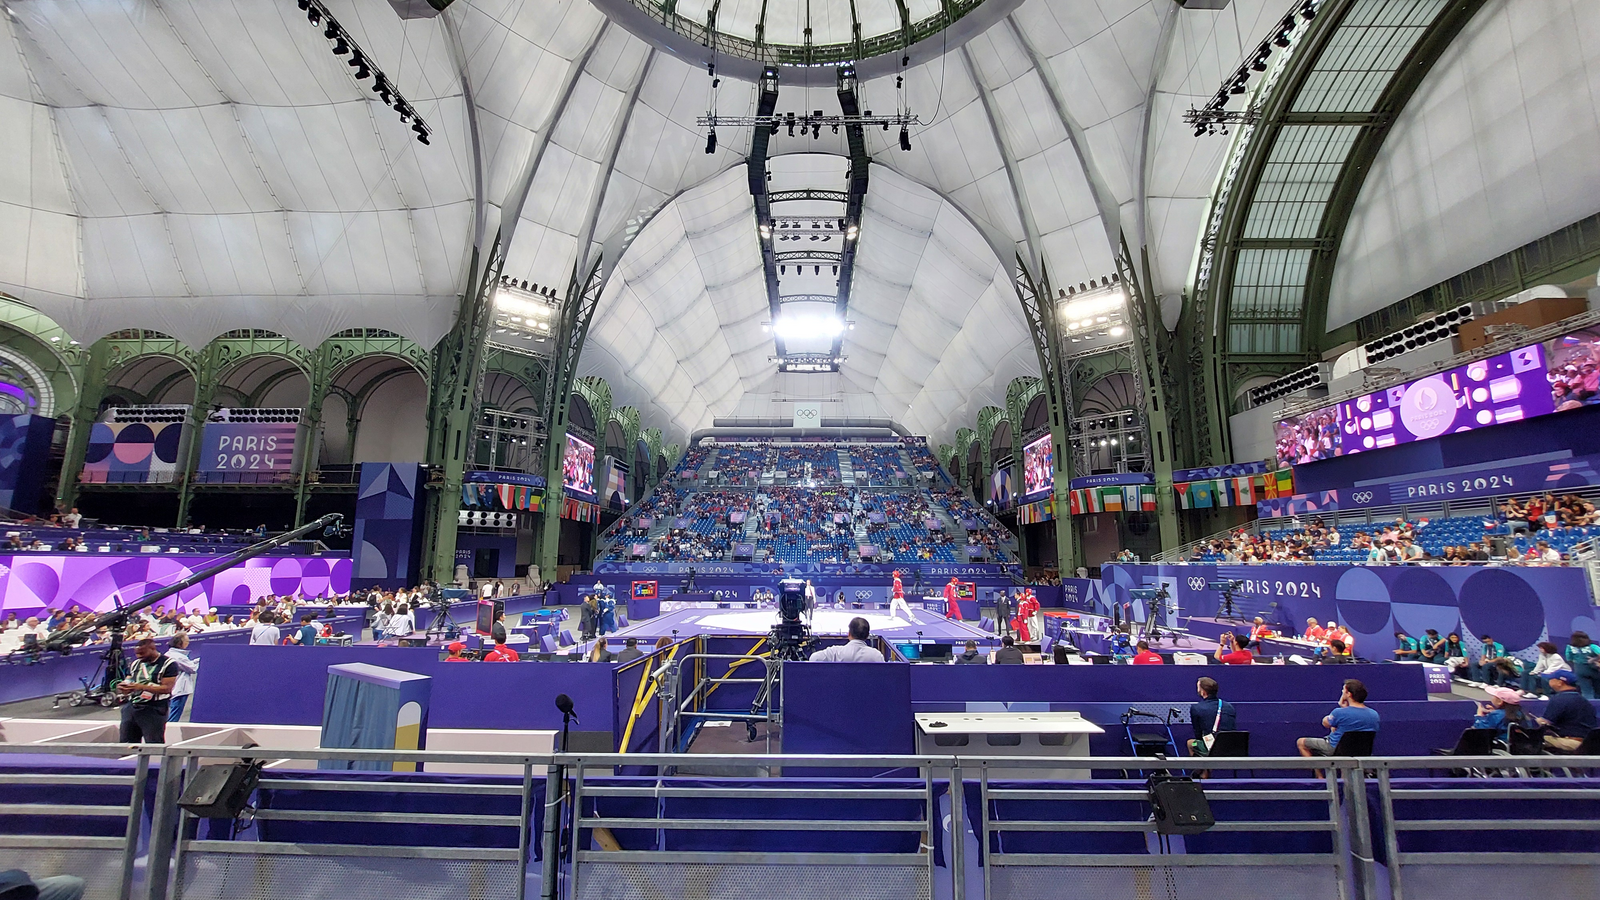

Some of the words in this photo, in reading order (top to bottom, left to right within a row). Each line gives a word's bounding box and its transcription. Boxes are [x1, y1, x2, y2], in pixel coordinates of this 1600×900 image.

[216, 453, 275, 469] 2024
[1462, 474, 1513, 492] 2024
[1275, 581, 1320, 598] 2024
